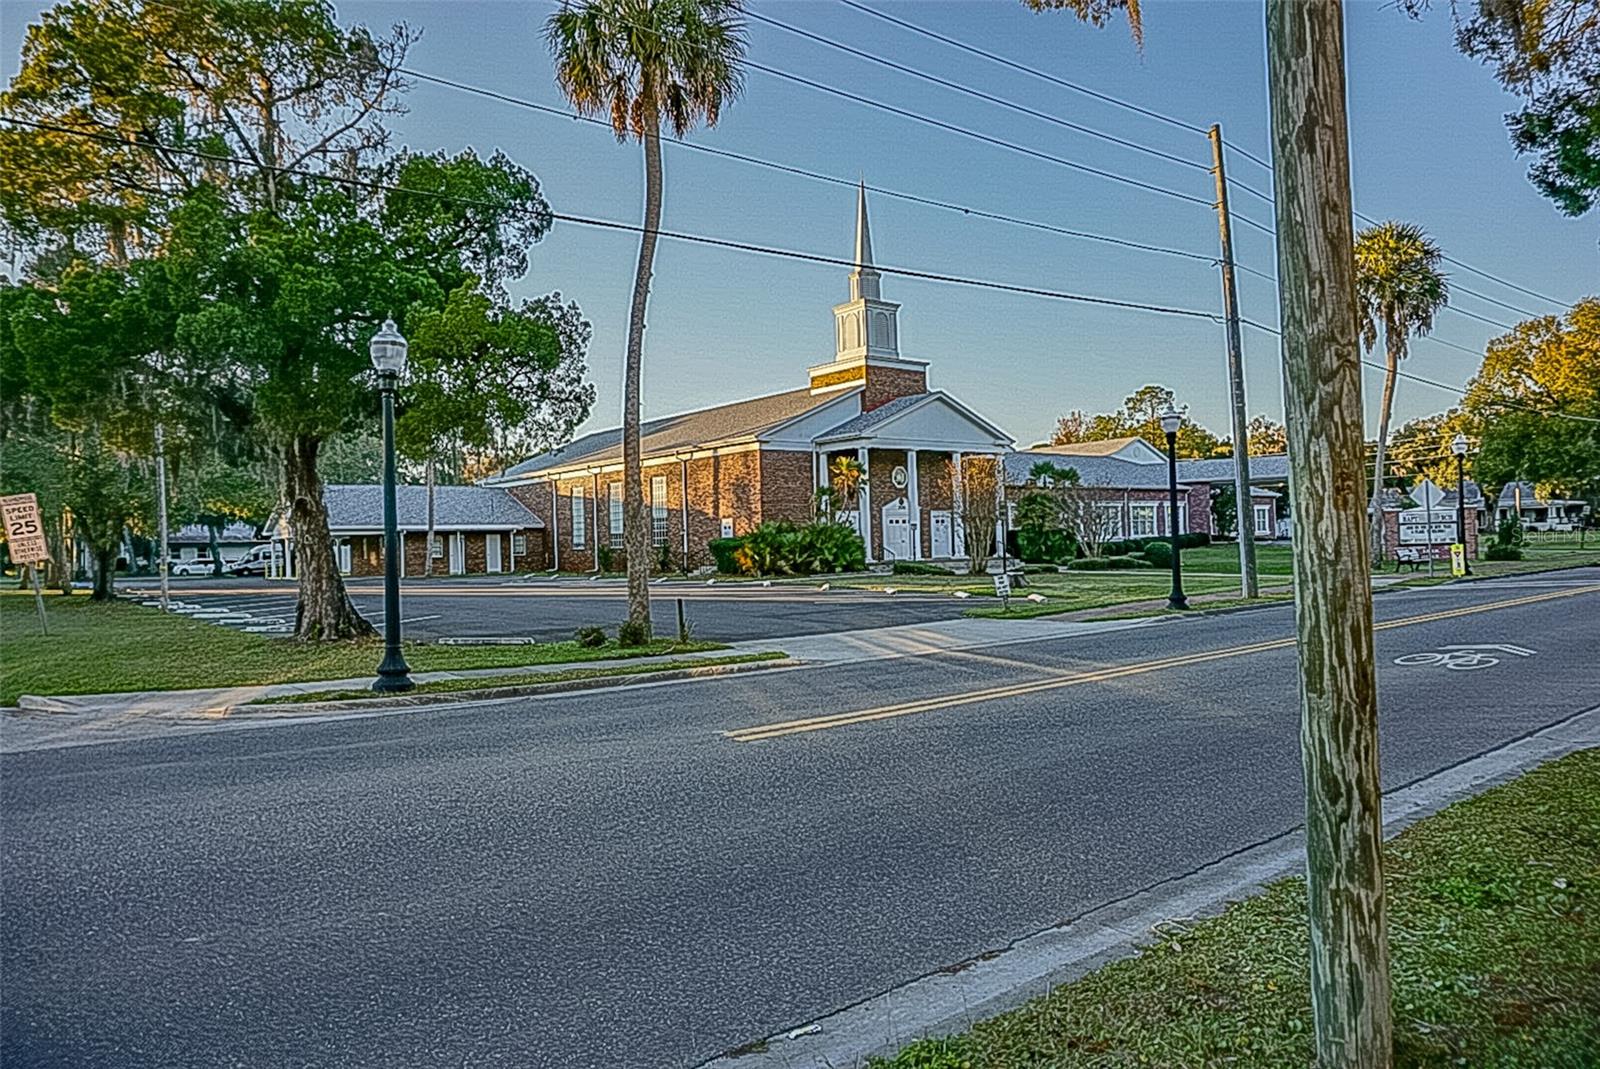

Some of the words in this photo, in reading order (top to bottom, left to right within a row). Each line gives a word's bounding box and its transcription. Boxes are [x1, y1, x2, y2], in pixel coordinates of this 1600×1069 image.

[5, 505, 34, 515] SPEED
[10, 513, 32, 521] LIMIT
[10, 520, 38, 535] 25
